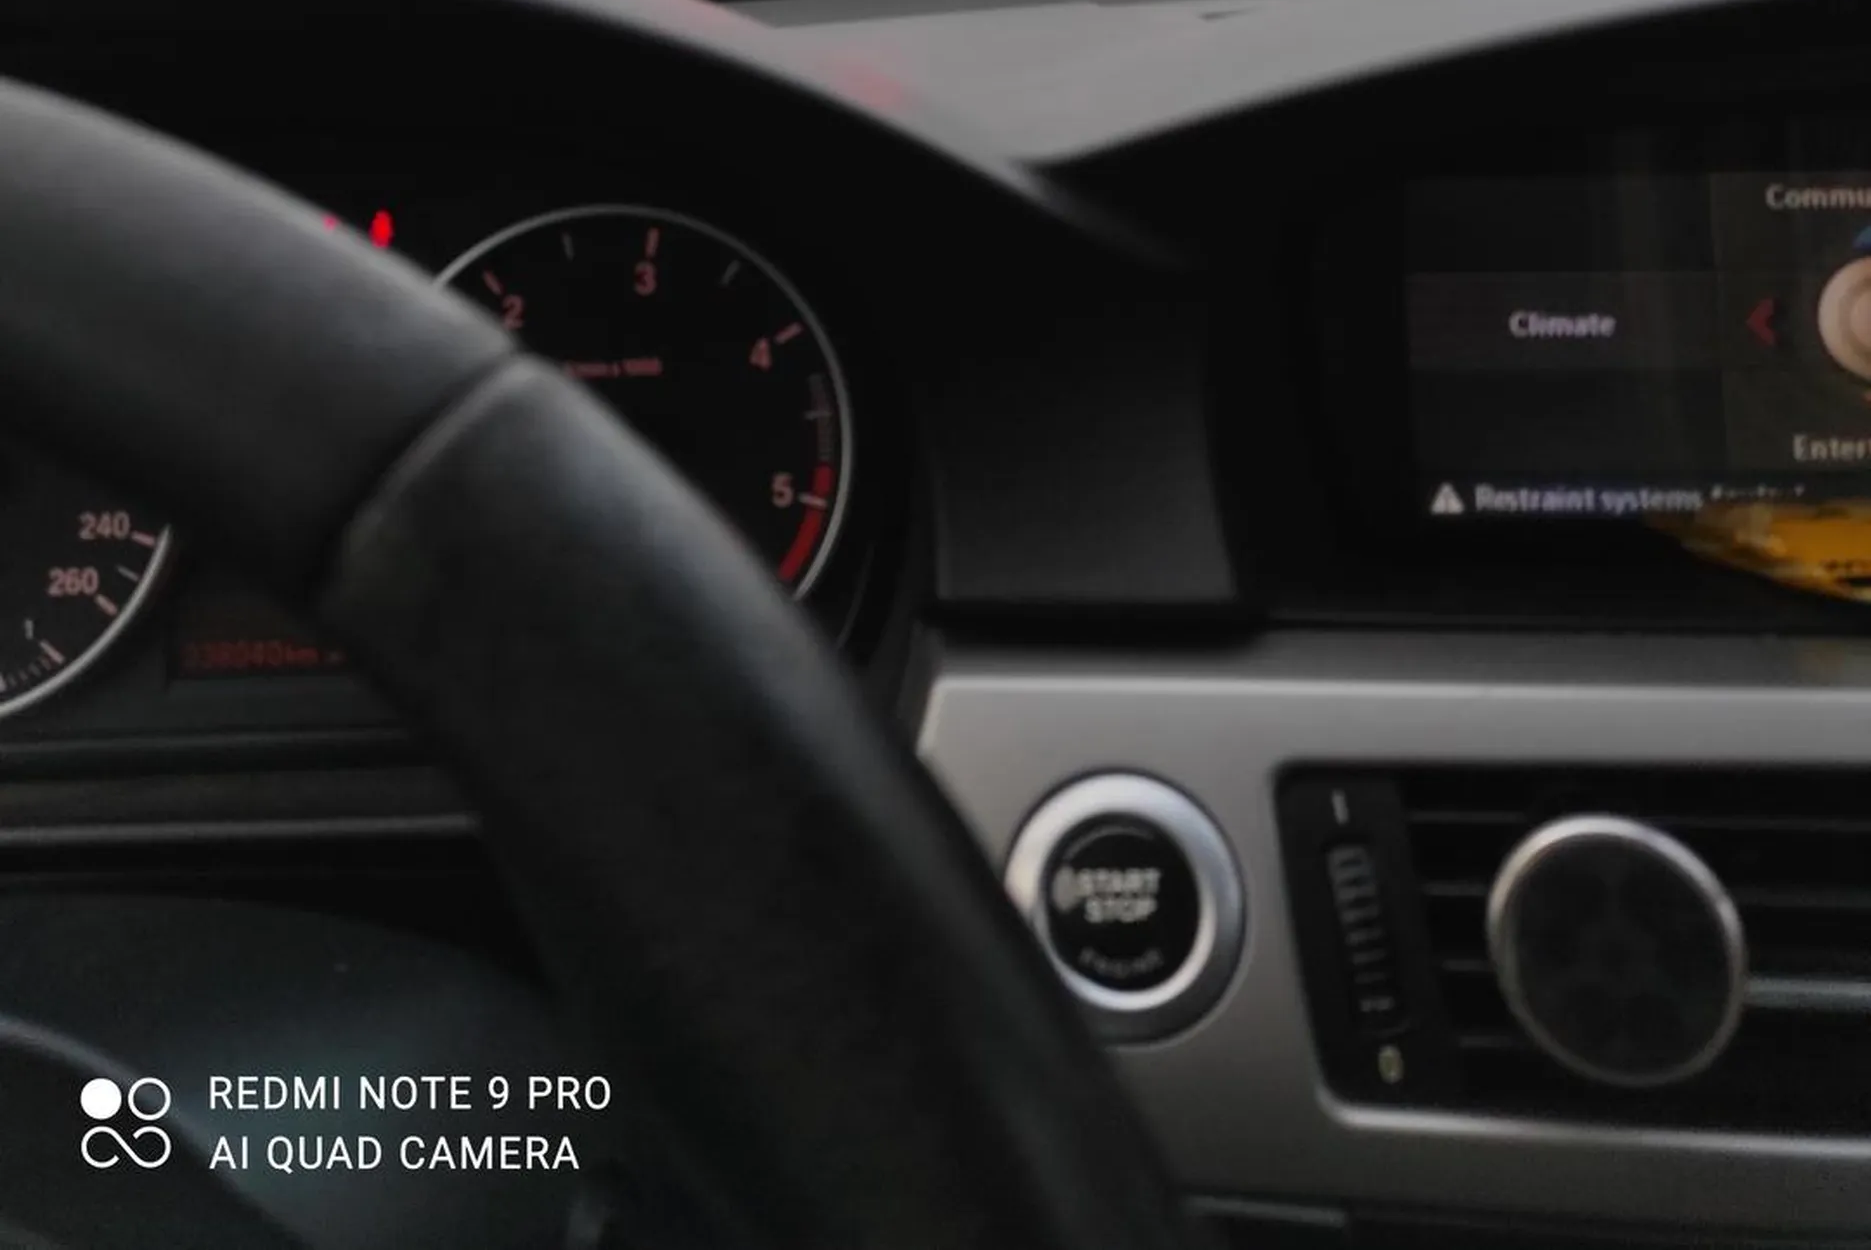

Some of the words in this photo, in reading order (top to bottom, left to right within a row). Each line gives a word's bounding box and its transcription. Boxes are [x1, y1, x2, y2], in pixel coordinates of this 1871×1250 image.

[633, 261, 657, 295] 3
[502, 294, 525, 330] 2
[1508, 310, 1617, 338] Climate
[749, 338, 773, 370] 4
[1793, 434, 1871, 462] Enter
[771, 472, 794, 508] 5
[1475, 483, 1595, 512] Restraint
[1601, 485, 1703, 517] systems
[79, 511, 130, 540] 240
[48, 566, 99, 597] 260
[1077, 867, 1161, 897] START
[1084, 896, 1158, 923] STOP
